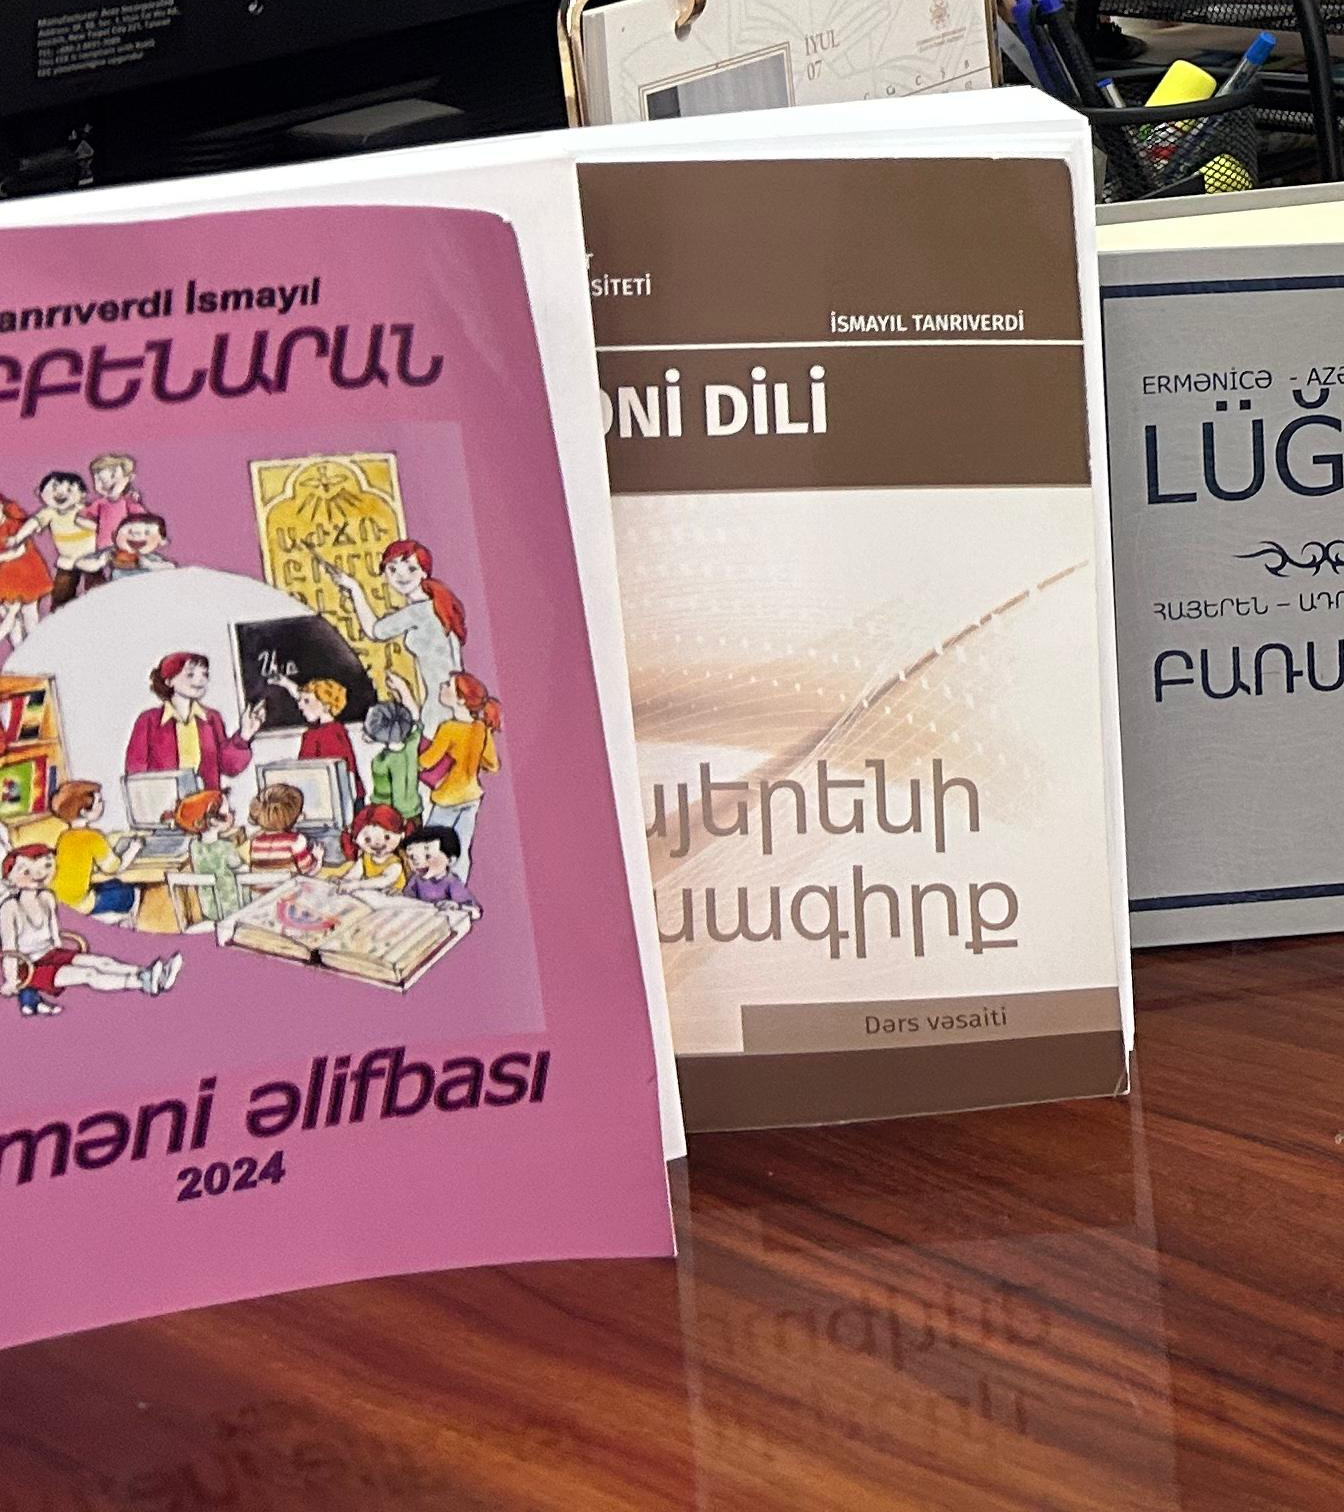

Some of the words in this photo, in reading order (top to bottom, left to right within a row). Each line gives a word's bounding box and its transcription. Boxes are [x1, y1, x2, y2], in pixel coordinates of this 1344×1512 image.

[807, 59, 823, 81] 07
[591, 273, 653, 298] SİTETİ
[830, 310, 908, 333] İSMAYIL
[912, 309, 1026, 333] TANRIVERDİ
[1143, 367, 1273, 395] ERMƏNİCƏ
[705, 364, 829, 437] DİLİ
[1153, 596, 1269, 621] ՀԱՅԵՐԵՆ
[865, 1013, 919, 1035] Dərs
[927, 1007, 1008, 1031] vəsaiti
[245, 1046, 551, 1140] əlifbası
[176, 1150, 286, 1201] 2024
